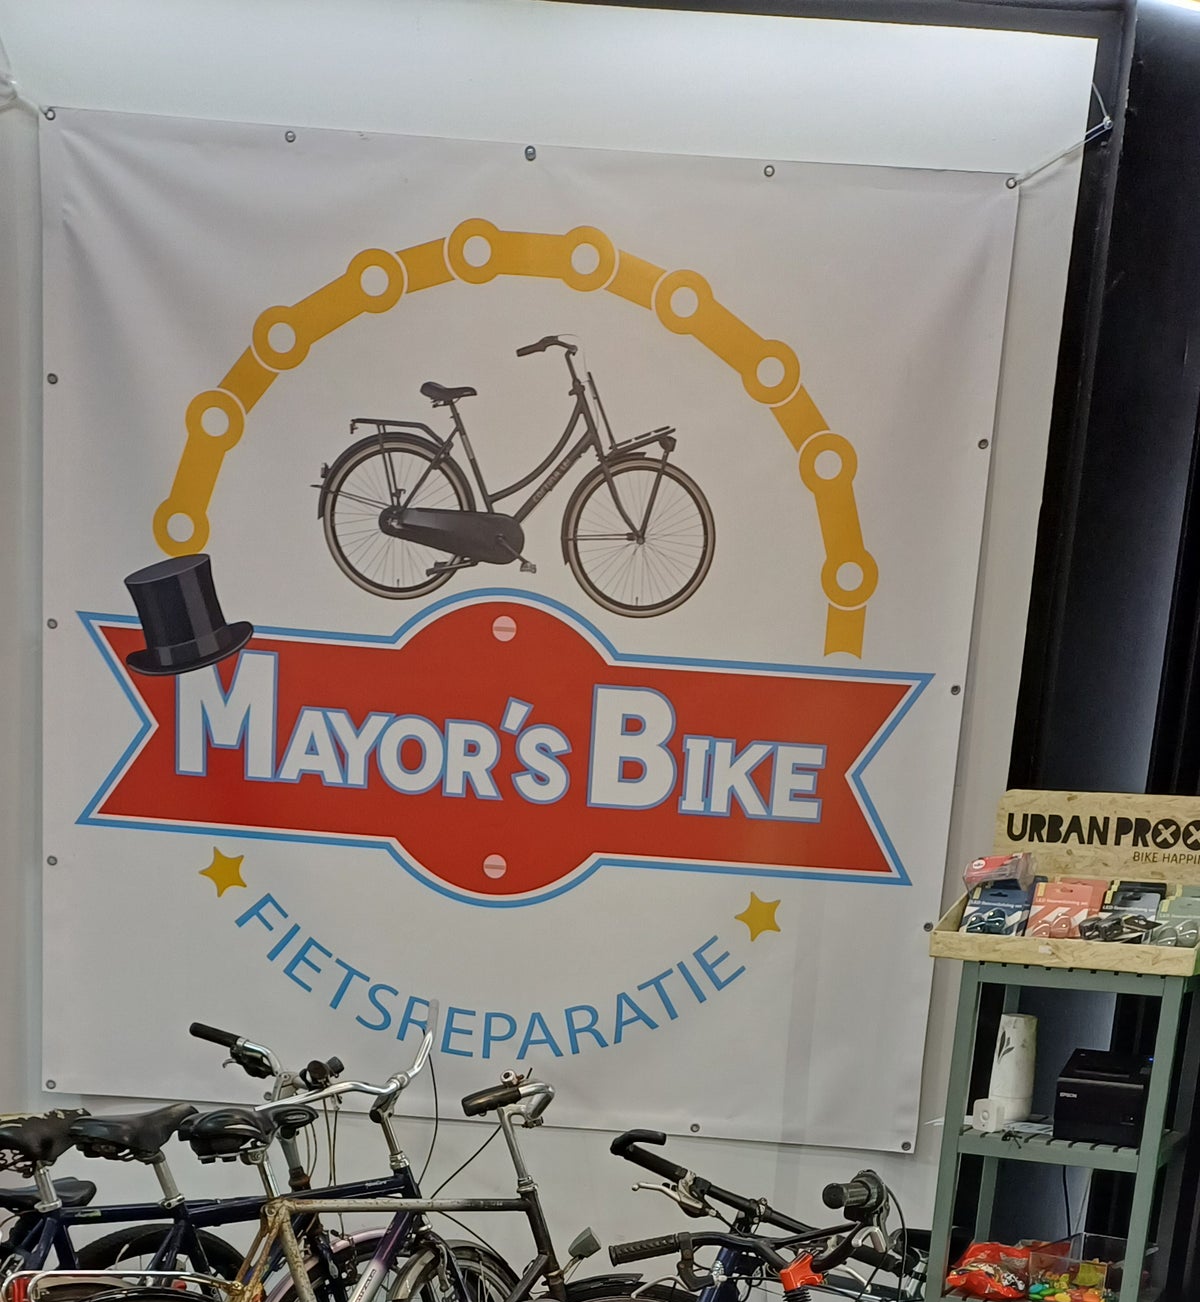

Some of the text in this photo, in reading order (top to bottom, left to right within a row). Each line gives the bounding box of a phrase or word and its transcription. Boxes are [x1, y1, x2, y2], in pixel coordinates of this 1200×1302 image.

[1007, 812, 1110, 846] URBAN
[1133, 851, 1200, 865] BIKE HAPPI
[235, 893, 746, 1060] FIETSREPARATIE
